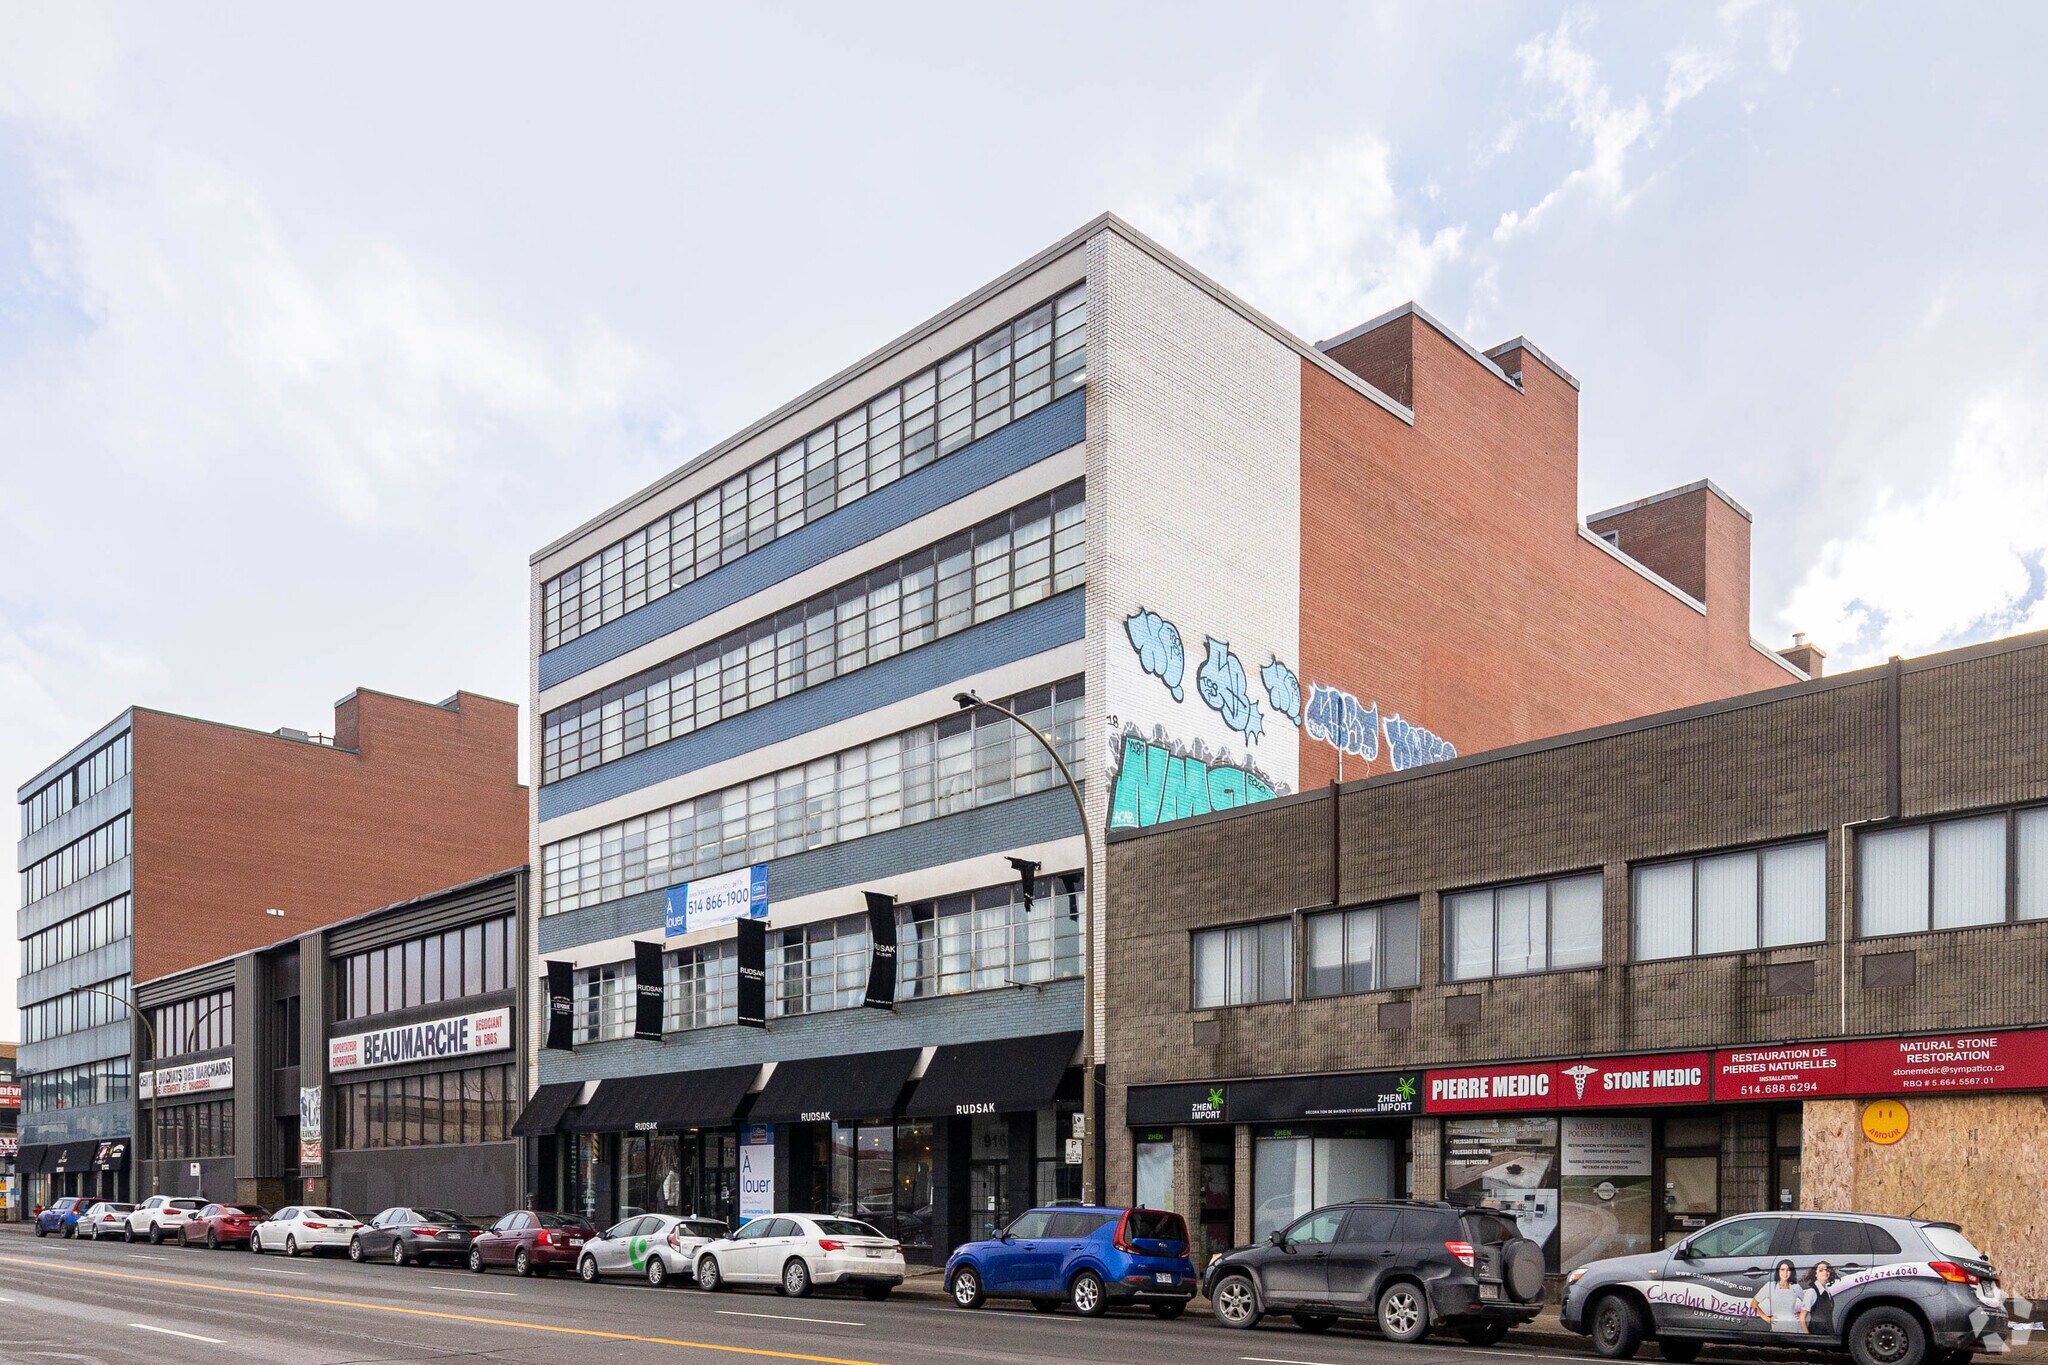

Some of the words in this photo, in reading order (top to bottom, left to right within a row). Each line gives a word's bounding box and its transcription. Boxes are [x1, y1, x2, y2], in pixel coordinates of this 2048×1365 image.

[667, 898, 673, 914] À
[688, 901, 703, 914] 514
[706, 888, 749, 910] 866-1900
[666, 914, 684, 928] louer
[740, 967, 764, 977] RUDSAK
[637, 984, 663, 993] RUDSAK
[364, 1017, 468, 1065] BEAUMARCHÉ
[476, 1034, 481, 1046] EN
[484, 1032, 497, 1045] GROS
[1900, 1041, 1954, 1052] NATURAL
[1957, 1038, 1997, 1048] STONE
[1732, 1049, 1810, 1062] RESTAURATION
[1813, 1048, 1827, 1057] DE
[1907, 1051, 1990, 1063] RESTORATION
[184, 1066, 195, 1081] DES
[196, 1061, 231, 1079] MARCHANDS
[1723, 1064, 1766, 1074] PIERRES
[1769, 1059, 1837, 1071] NATURELLES
[1893, 1065, 2004, 1076] stonemedic@sympatico.ca
[1604, 1071, 1650, 1090] STONE
[1653, 1068, 1701, 1087] MEDIC
[1932, 1077, 1994, 1086] 5.664.5567.01
[1432, 1077, 1489, 1100] PIERRE
[1493, 1074, 1549, 1098] MEDIC
[1741, 1082, 1817, 1094] 514.688.6294
[1378, 1094, 1401, 1103] ZHEN
[956, 1103, 995, 1114] RUDSAK
[1378, 1102, 1412, 1112] IMPORT
[801, 1112, 831, 1121] RUDSAK
[1192, 1111, 1221, 1119] IMPORT
[634, 1122, 658, 1130] RUDSAK
[1868, 1128, 1900, 1139] AMOUR
[743, 1150, 751, 1173] À
[743, 1175, 771, 1192] louer
[1676, 1271, 1753, 1292] www.carolyndesign.com
[1646, 1284, 1705, 1313] Carolyn
[1711, 1295, 1758, 1318] Design
[1693, 1310, 1741, 1324] UNIFORMES
